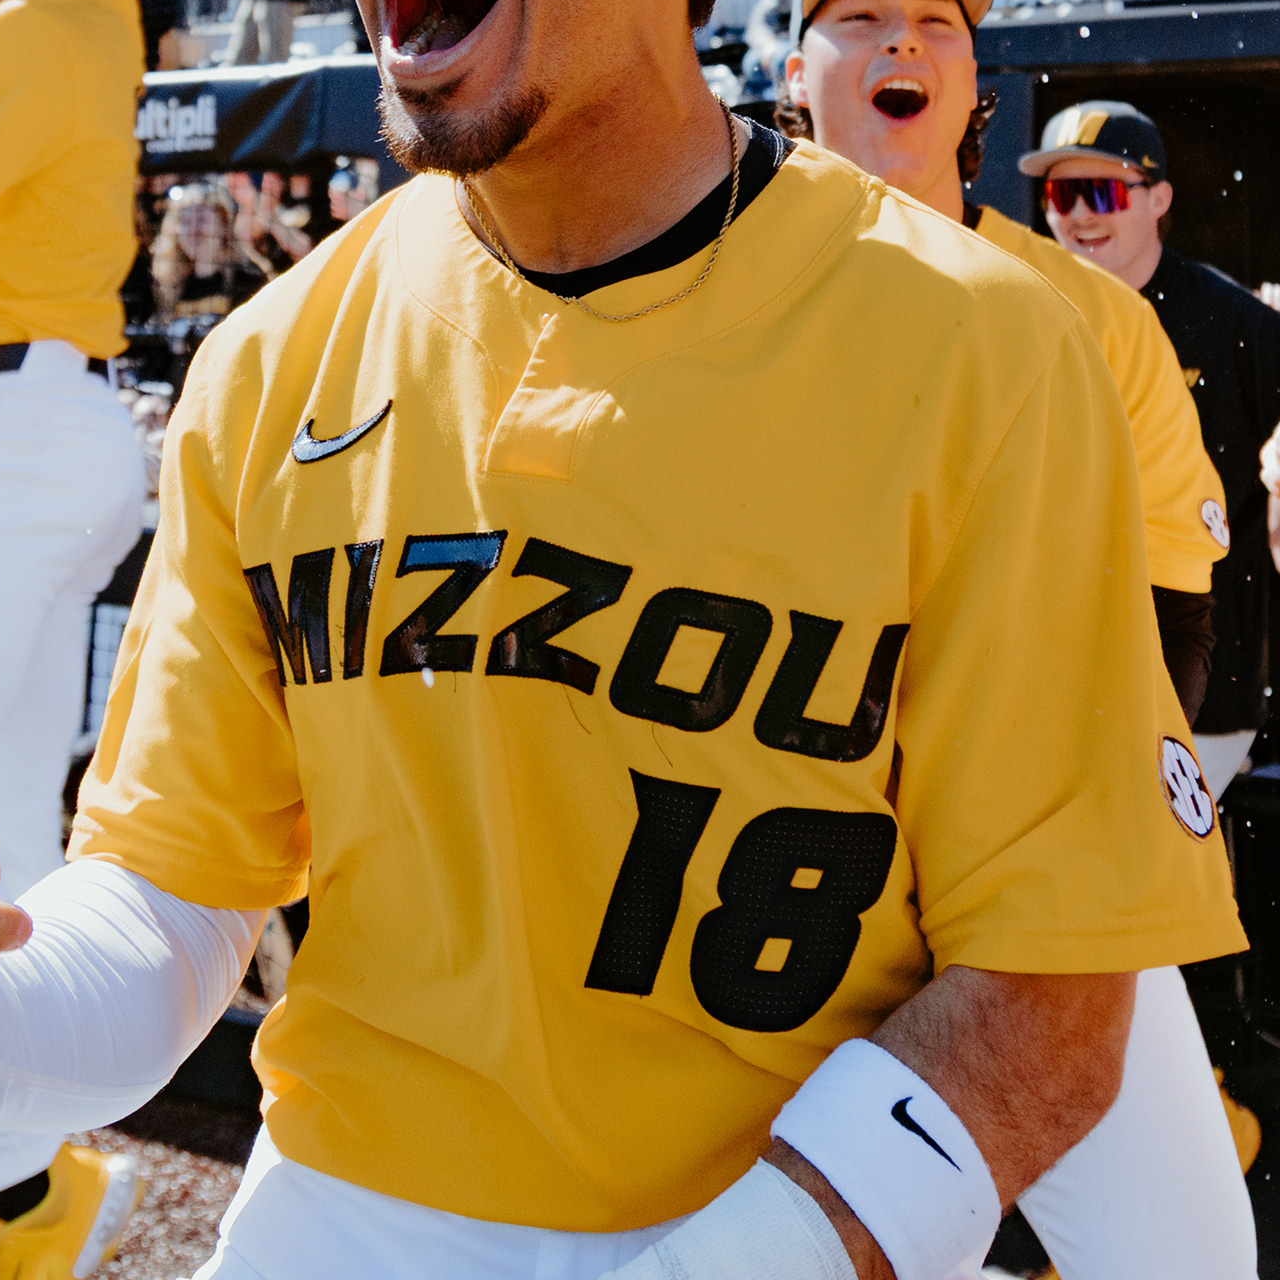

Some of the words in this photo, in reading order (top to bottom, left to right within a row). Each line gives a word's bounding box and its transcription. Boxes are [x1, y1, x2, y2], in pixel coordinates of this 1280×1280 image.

[242, 529, 912, 763] MIZZOU
[583, 767, 898, 1033] 18
[1162, 738, 1214, 836] SEC
